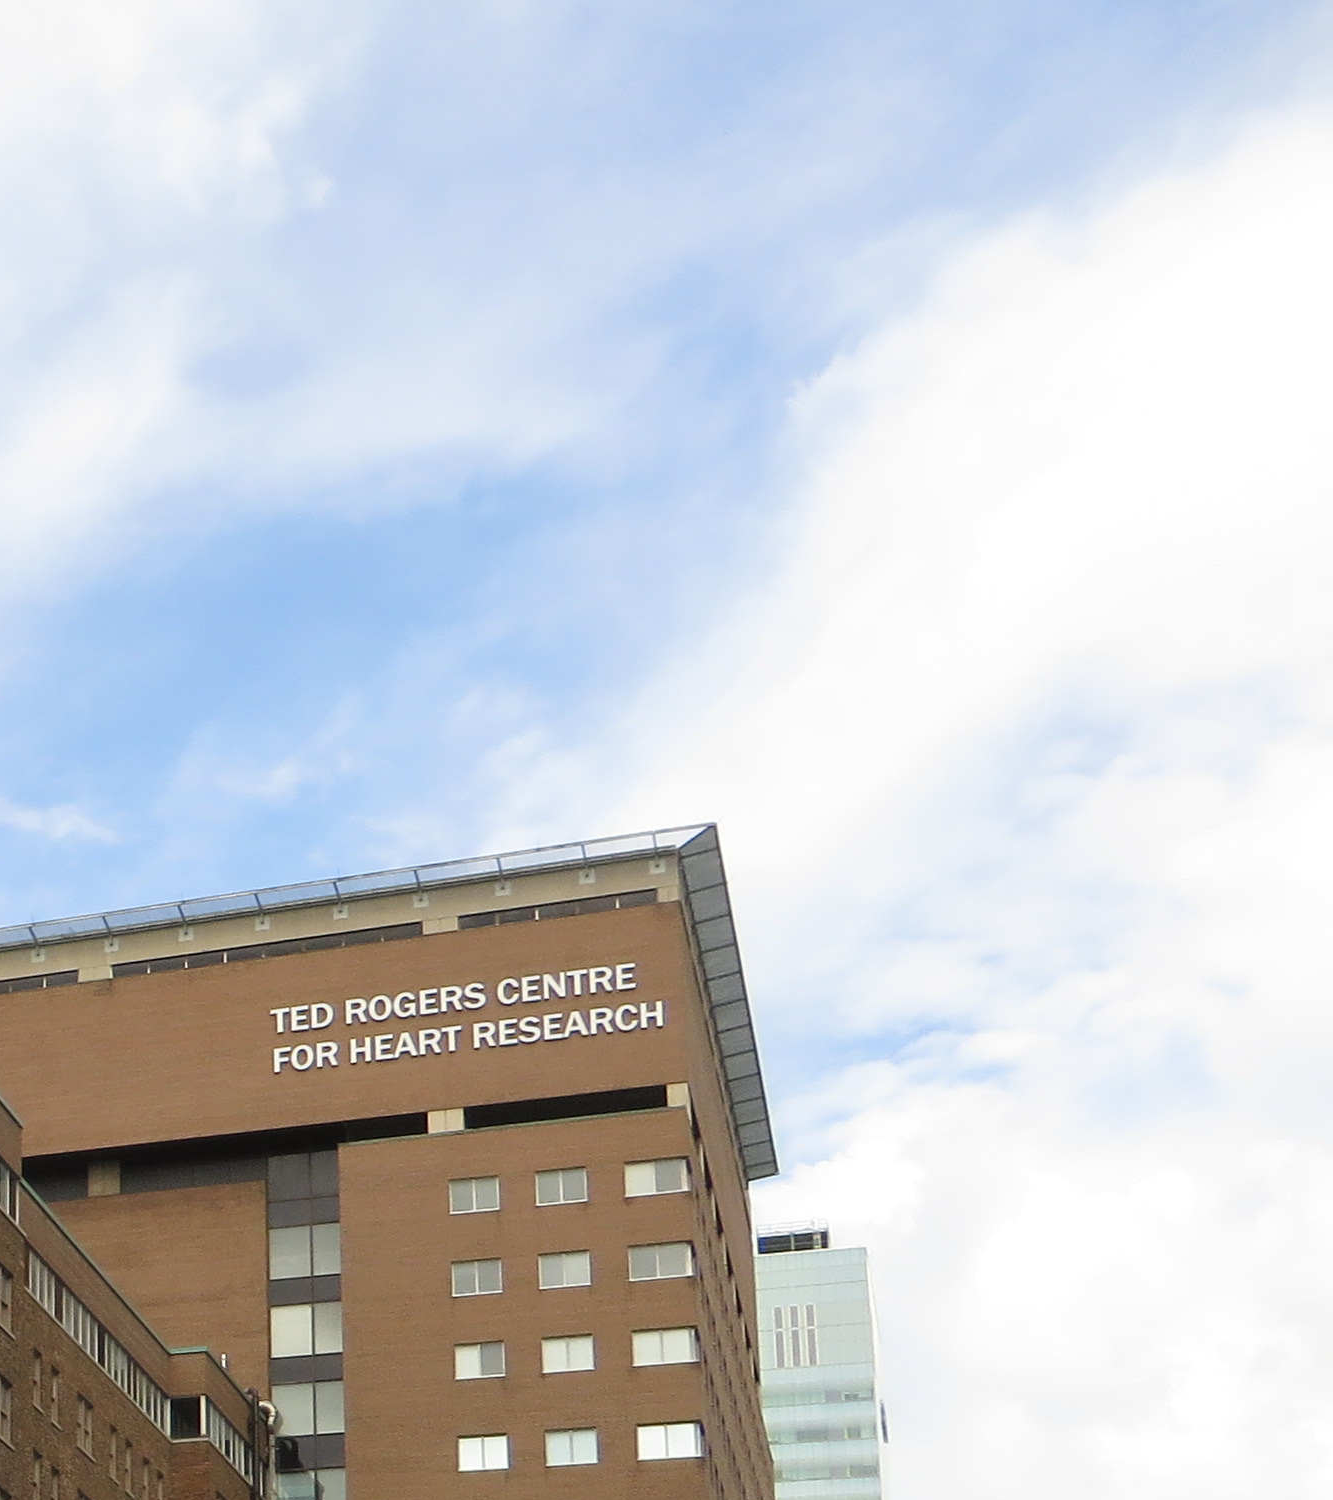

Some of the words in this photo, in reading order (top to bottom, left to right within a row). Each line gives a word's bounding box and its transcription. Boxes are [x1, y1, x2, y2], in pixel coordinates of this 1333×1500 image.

[270, 1002, 334, 1034] TED
[345, 982, 487, 1026] ROGERS
[497, 962, 637, 1006] CENTRE
[273, 1041, 339, 1074] FOR
[349, 1025, 463, 1065] HEART
[472, 1001, 665, 1050] RESEARCH
